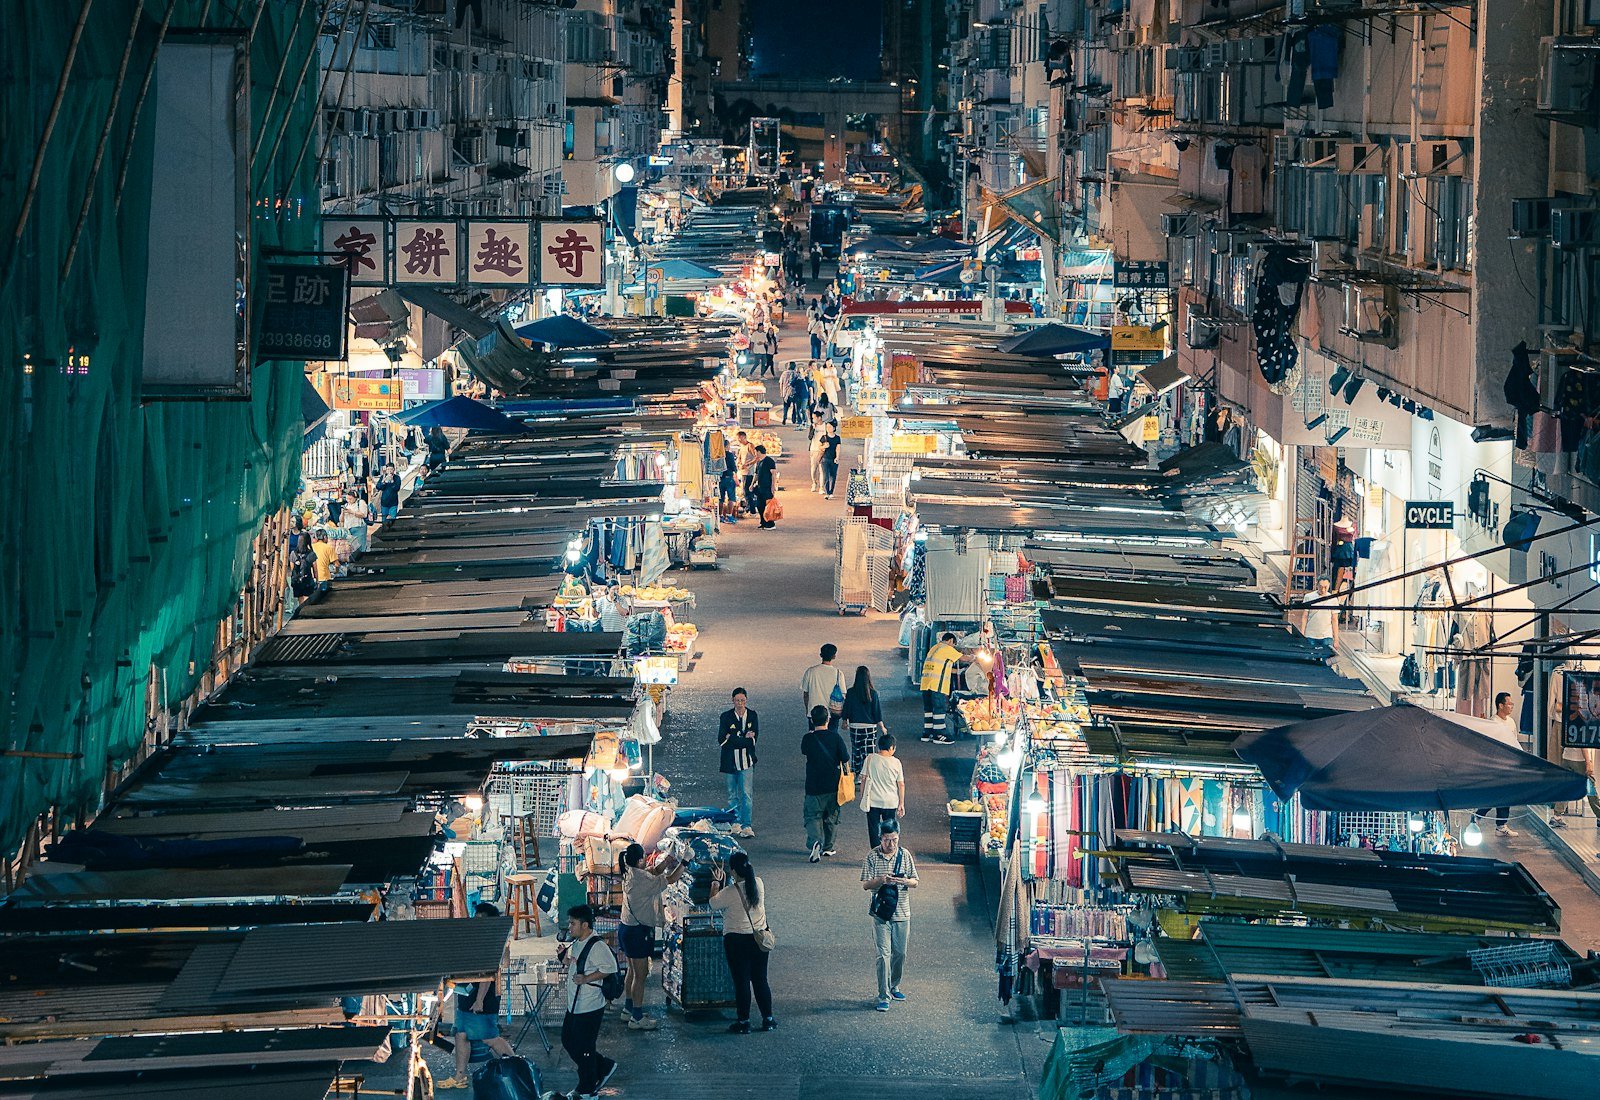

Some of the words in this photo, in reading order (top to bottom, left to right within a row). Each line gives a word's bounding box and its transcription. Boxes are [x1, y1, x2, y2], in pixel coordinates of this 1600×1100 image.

[1358, 418, 1380, 431] 通渠
[1408, 507, 1452, 525] CYCLE
[1568, 725, 1600, 745] 917
